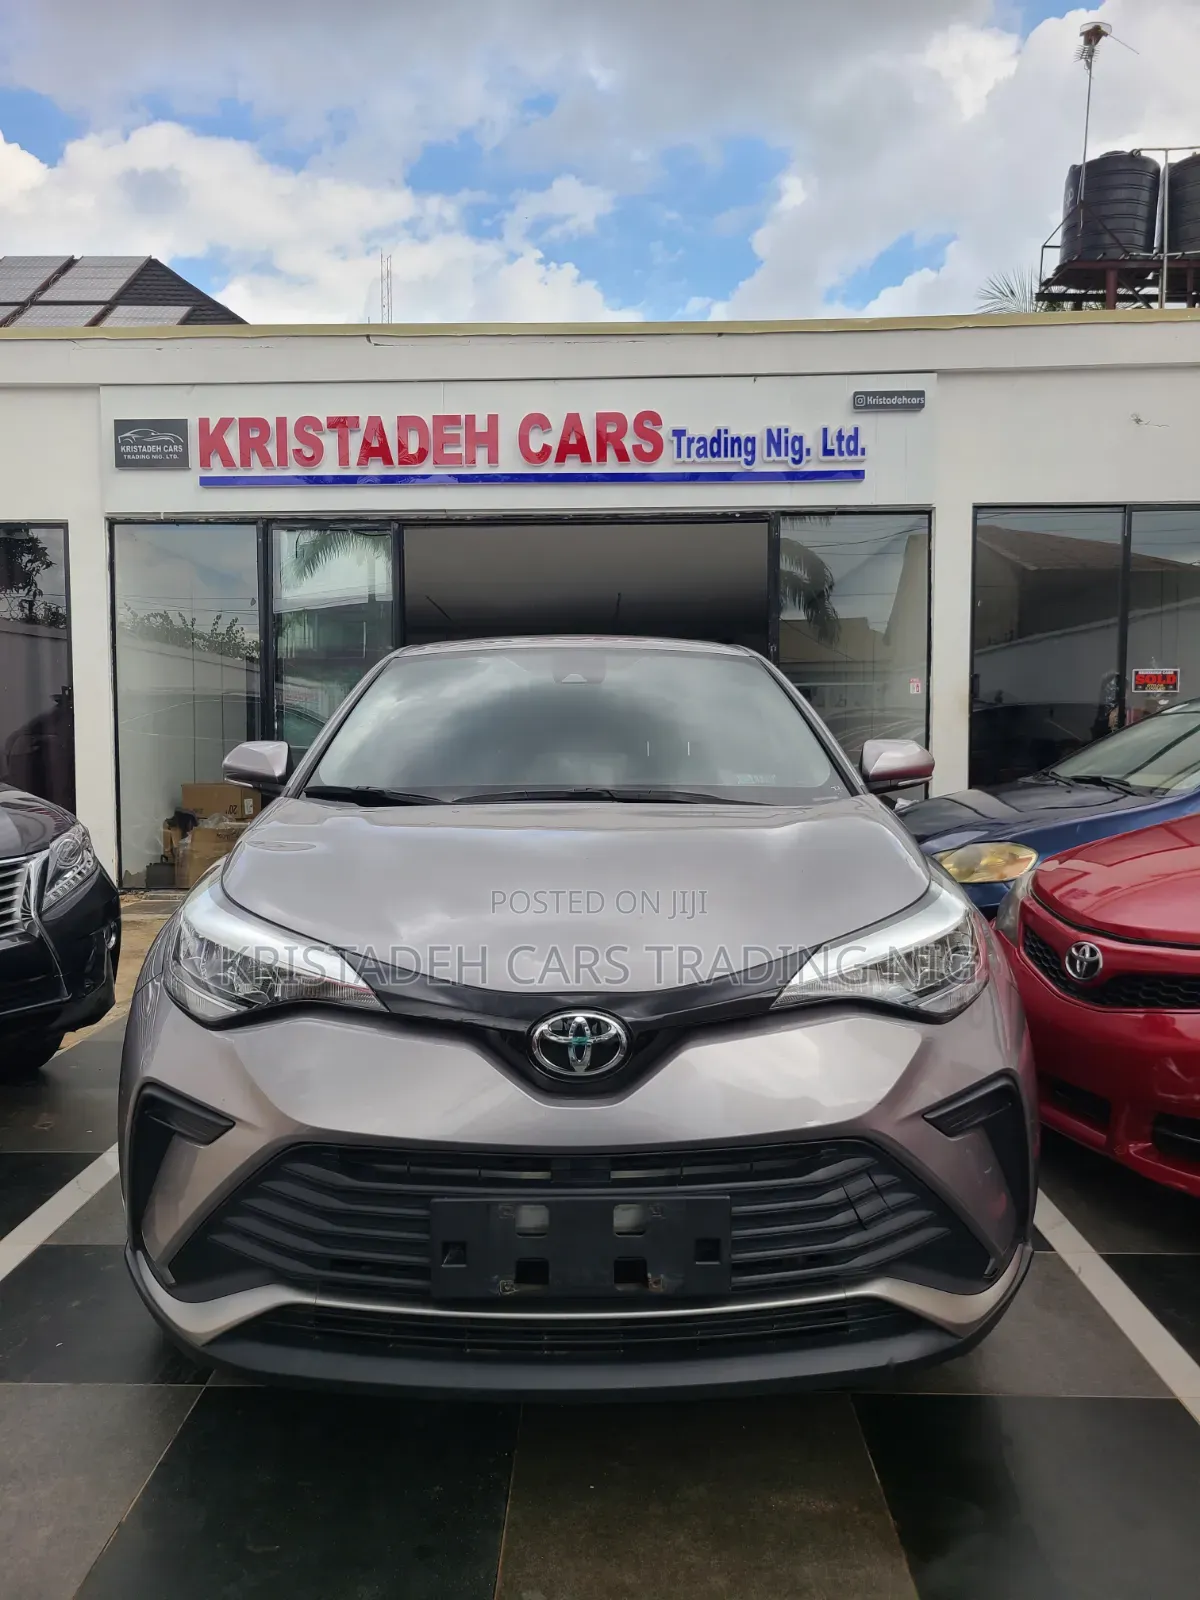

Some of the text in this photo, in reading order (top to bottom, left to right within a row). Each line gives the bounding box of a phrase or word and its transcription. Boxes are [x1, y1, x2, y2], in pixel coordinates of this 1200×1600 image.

[867, 395, 924, 405] Kristadehcars
[198, 410, 664, 469] KRISTADEH CARS
[120, 445, 183, 453] KRISTADEH CARS
[671, 426, 866, 467] Trading Nig. Ltd.
[1135, 674, 1177, 684] SOLD
